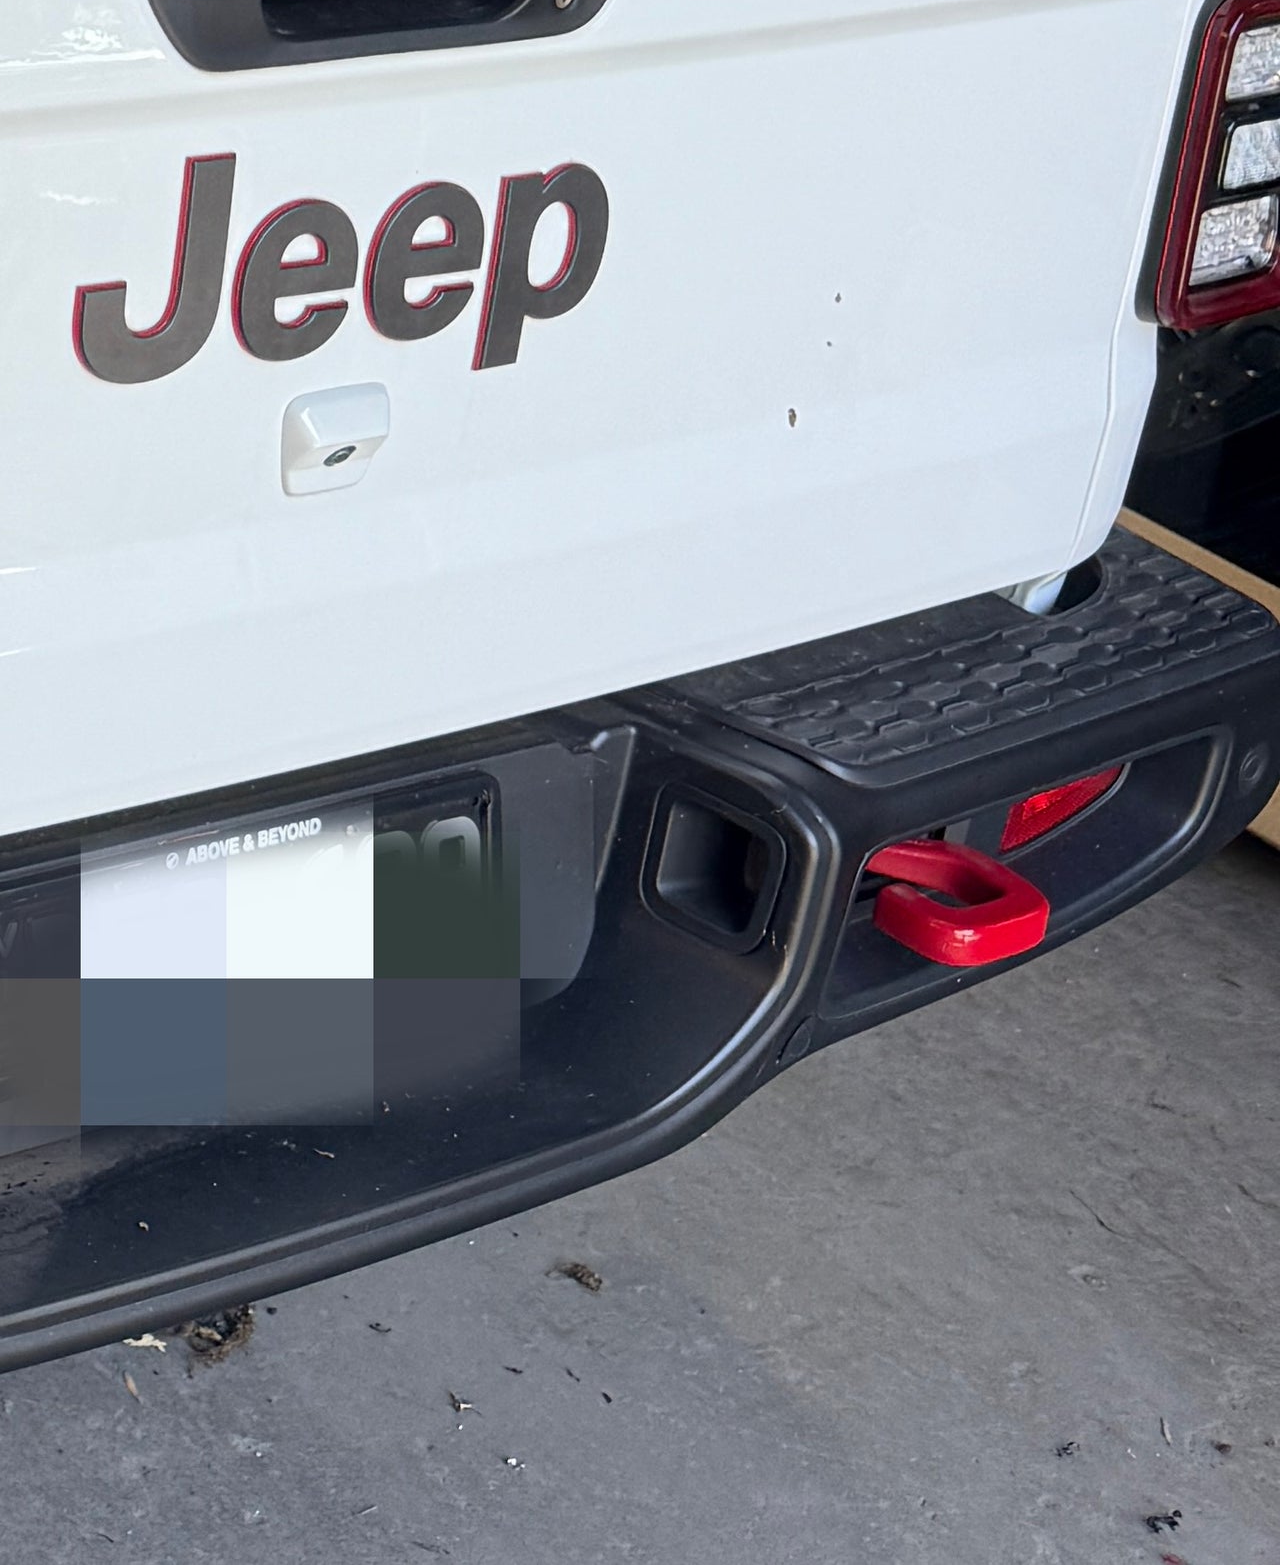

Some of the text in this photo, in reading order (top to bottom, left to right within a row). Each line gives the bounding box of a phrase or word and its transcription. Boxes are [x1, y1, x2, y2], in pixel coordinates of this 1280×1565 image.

[72, 152, 609, 384] Jeep
[184, 837, 240, 866] ABOVE
[242, 833, 255, 853] &
[257, 817, 323, 849] BEYOND
